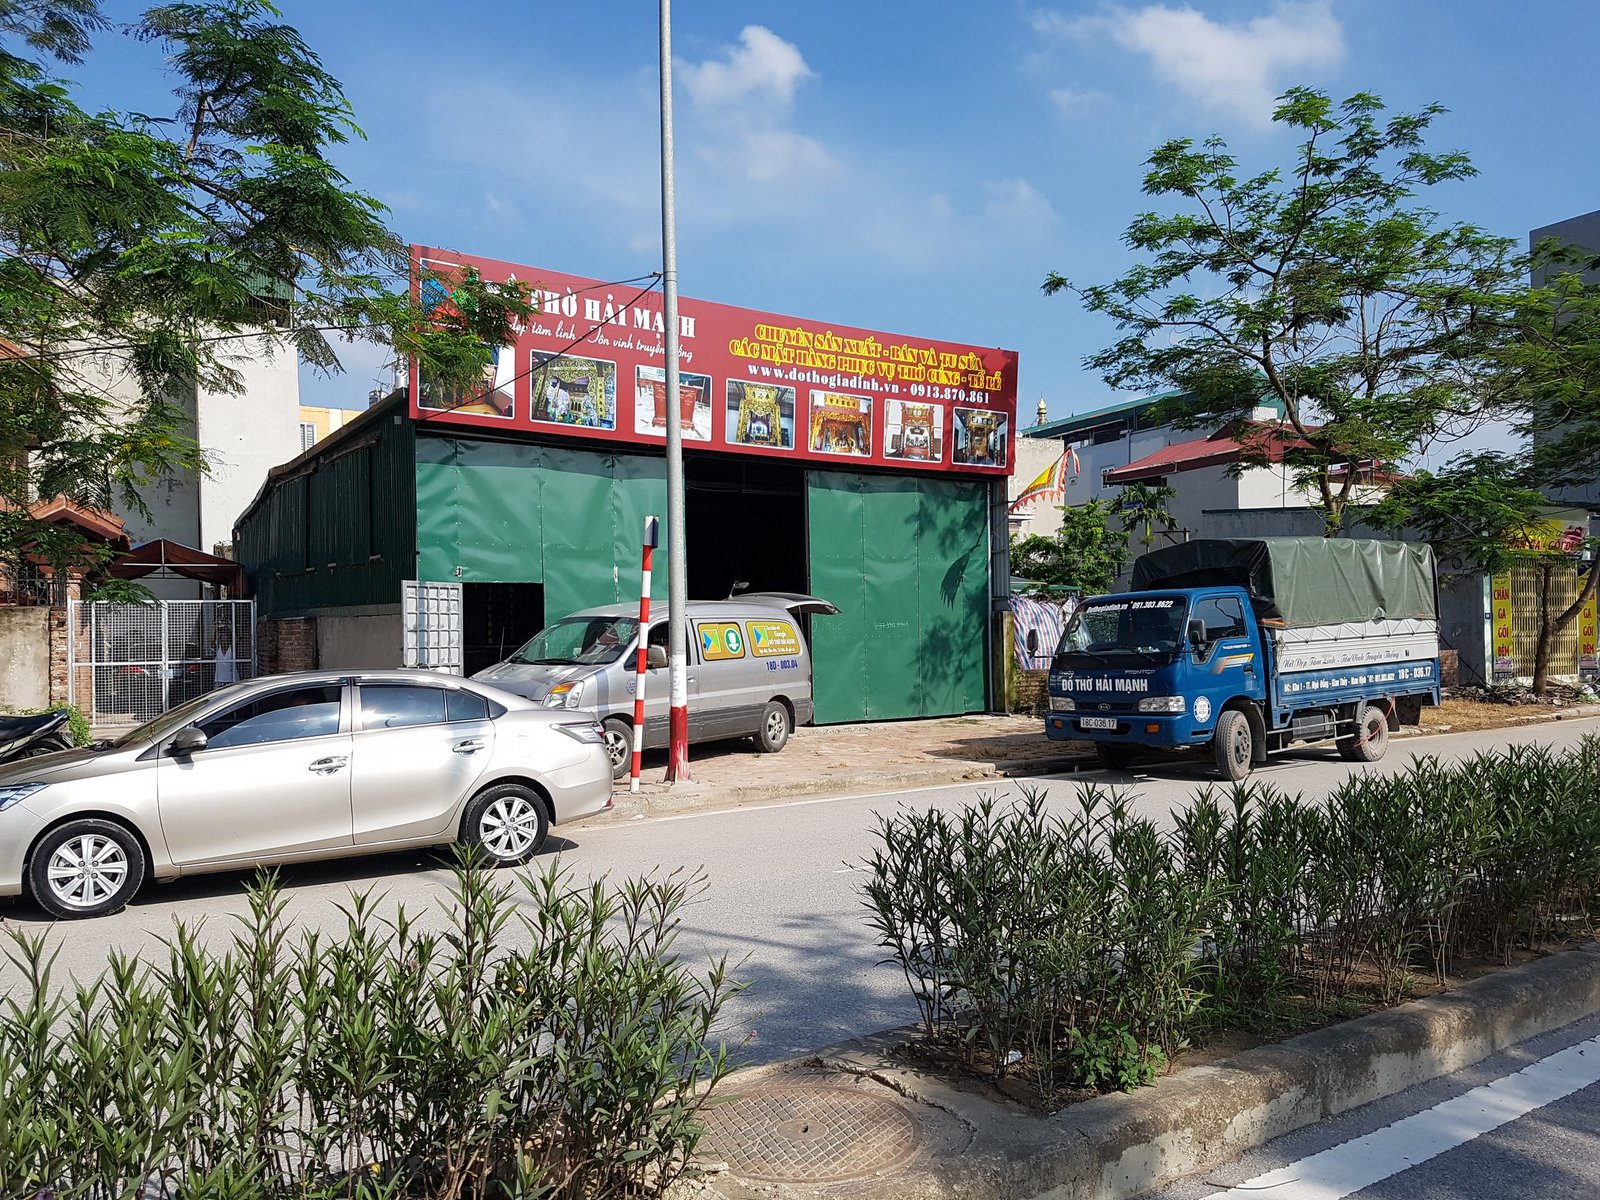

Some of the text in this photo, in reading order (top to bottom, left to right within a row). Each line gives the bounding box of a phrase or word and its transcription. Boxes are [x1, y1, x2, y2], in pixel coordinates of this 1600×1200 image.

[584, 294, 627, 326] HẢI
[633, 307, 696, 339] MẠH
[531, 322, 552, 336] tâm
[555, 320, 576, 340] linh
[613, 333, 633, 349] vinh
[754, 324, 813, 347] CHUYÊN
[814, 331, 843, 352] SẢN
[844, 336, 882, 358] XUẤT
[890, 344, 918, 363] BÁN
[919, 348, 938, 366] VÀ
[940, 352, 957, 368] TU
[729, 337, 759, 358] CÁC
[761, 343, 794, 366] MẶT
[796, 348, 836, 369] HÀNG
[838, 356, 876, 377] PHỤC
[877, 361, 895, 381] VỤ
[897, 363, 925, 381] THỜ
[927, 367, 960, 386] CÚNG
[748, 364, 899, 394] www.dothogiadinh.vn
[910, 383, 989, 404] 0913.870.861
[1498, 608, 1506, 619] GA
[1583, 608, 1592, 619] GA
[1076, 675, 1093, 692] THỜ
[1095, 674, 1113, 692] HẢI
[1115, 678, 1148, 694] MẠNH
